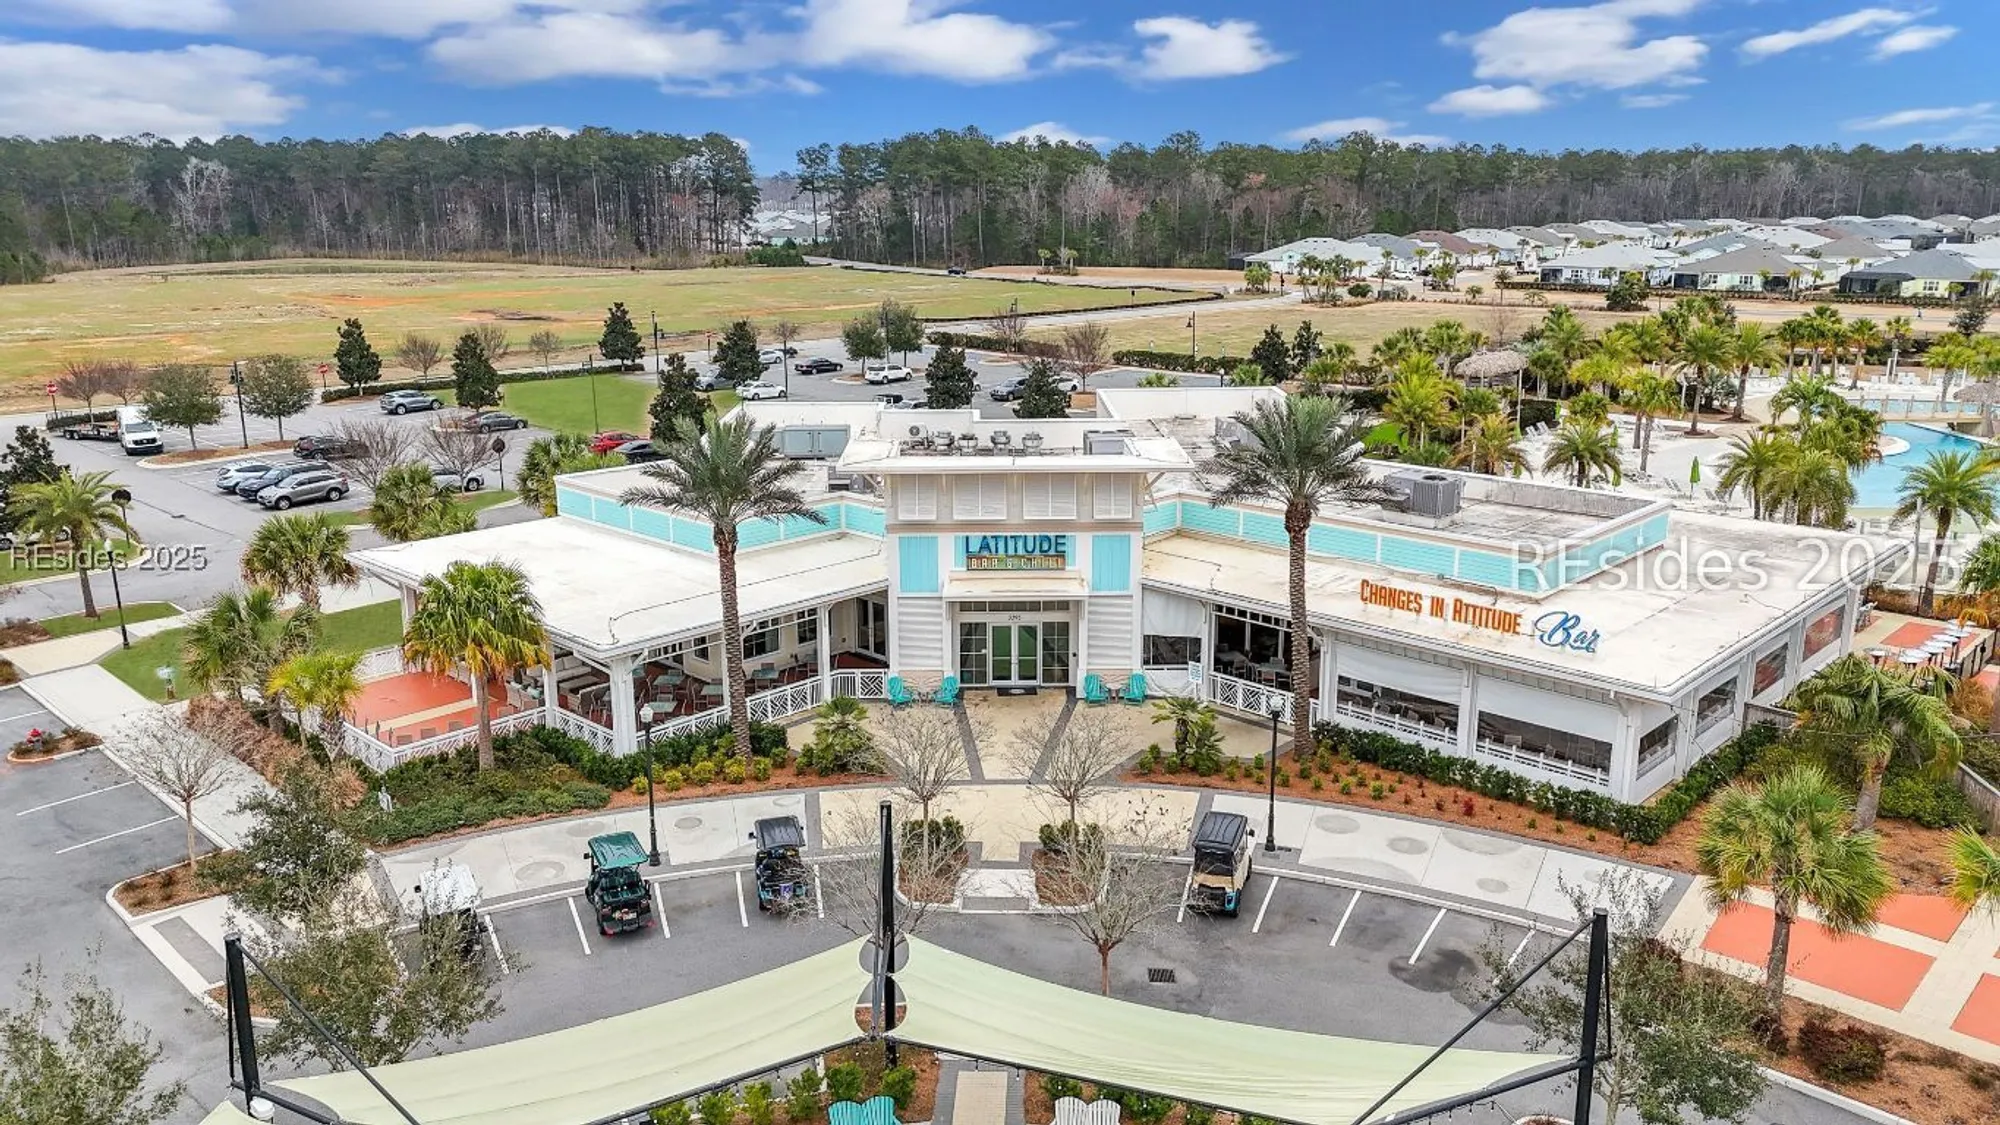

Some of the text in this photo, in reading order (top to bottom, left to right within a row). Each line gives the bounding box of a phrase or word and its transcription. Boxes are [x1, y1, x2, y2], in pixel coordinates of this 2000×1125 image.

[965, 535, 1066, 554] LATITUDE
[971, 558, 998, 569] BAR
[1021, 558, 1062, 569] CHILL
[1360, 579, 1600, 653] CHANGES IN ATTITUDE Bar
